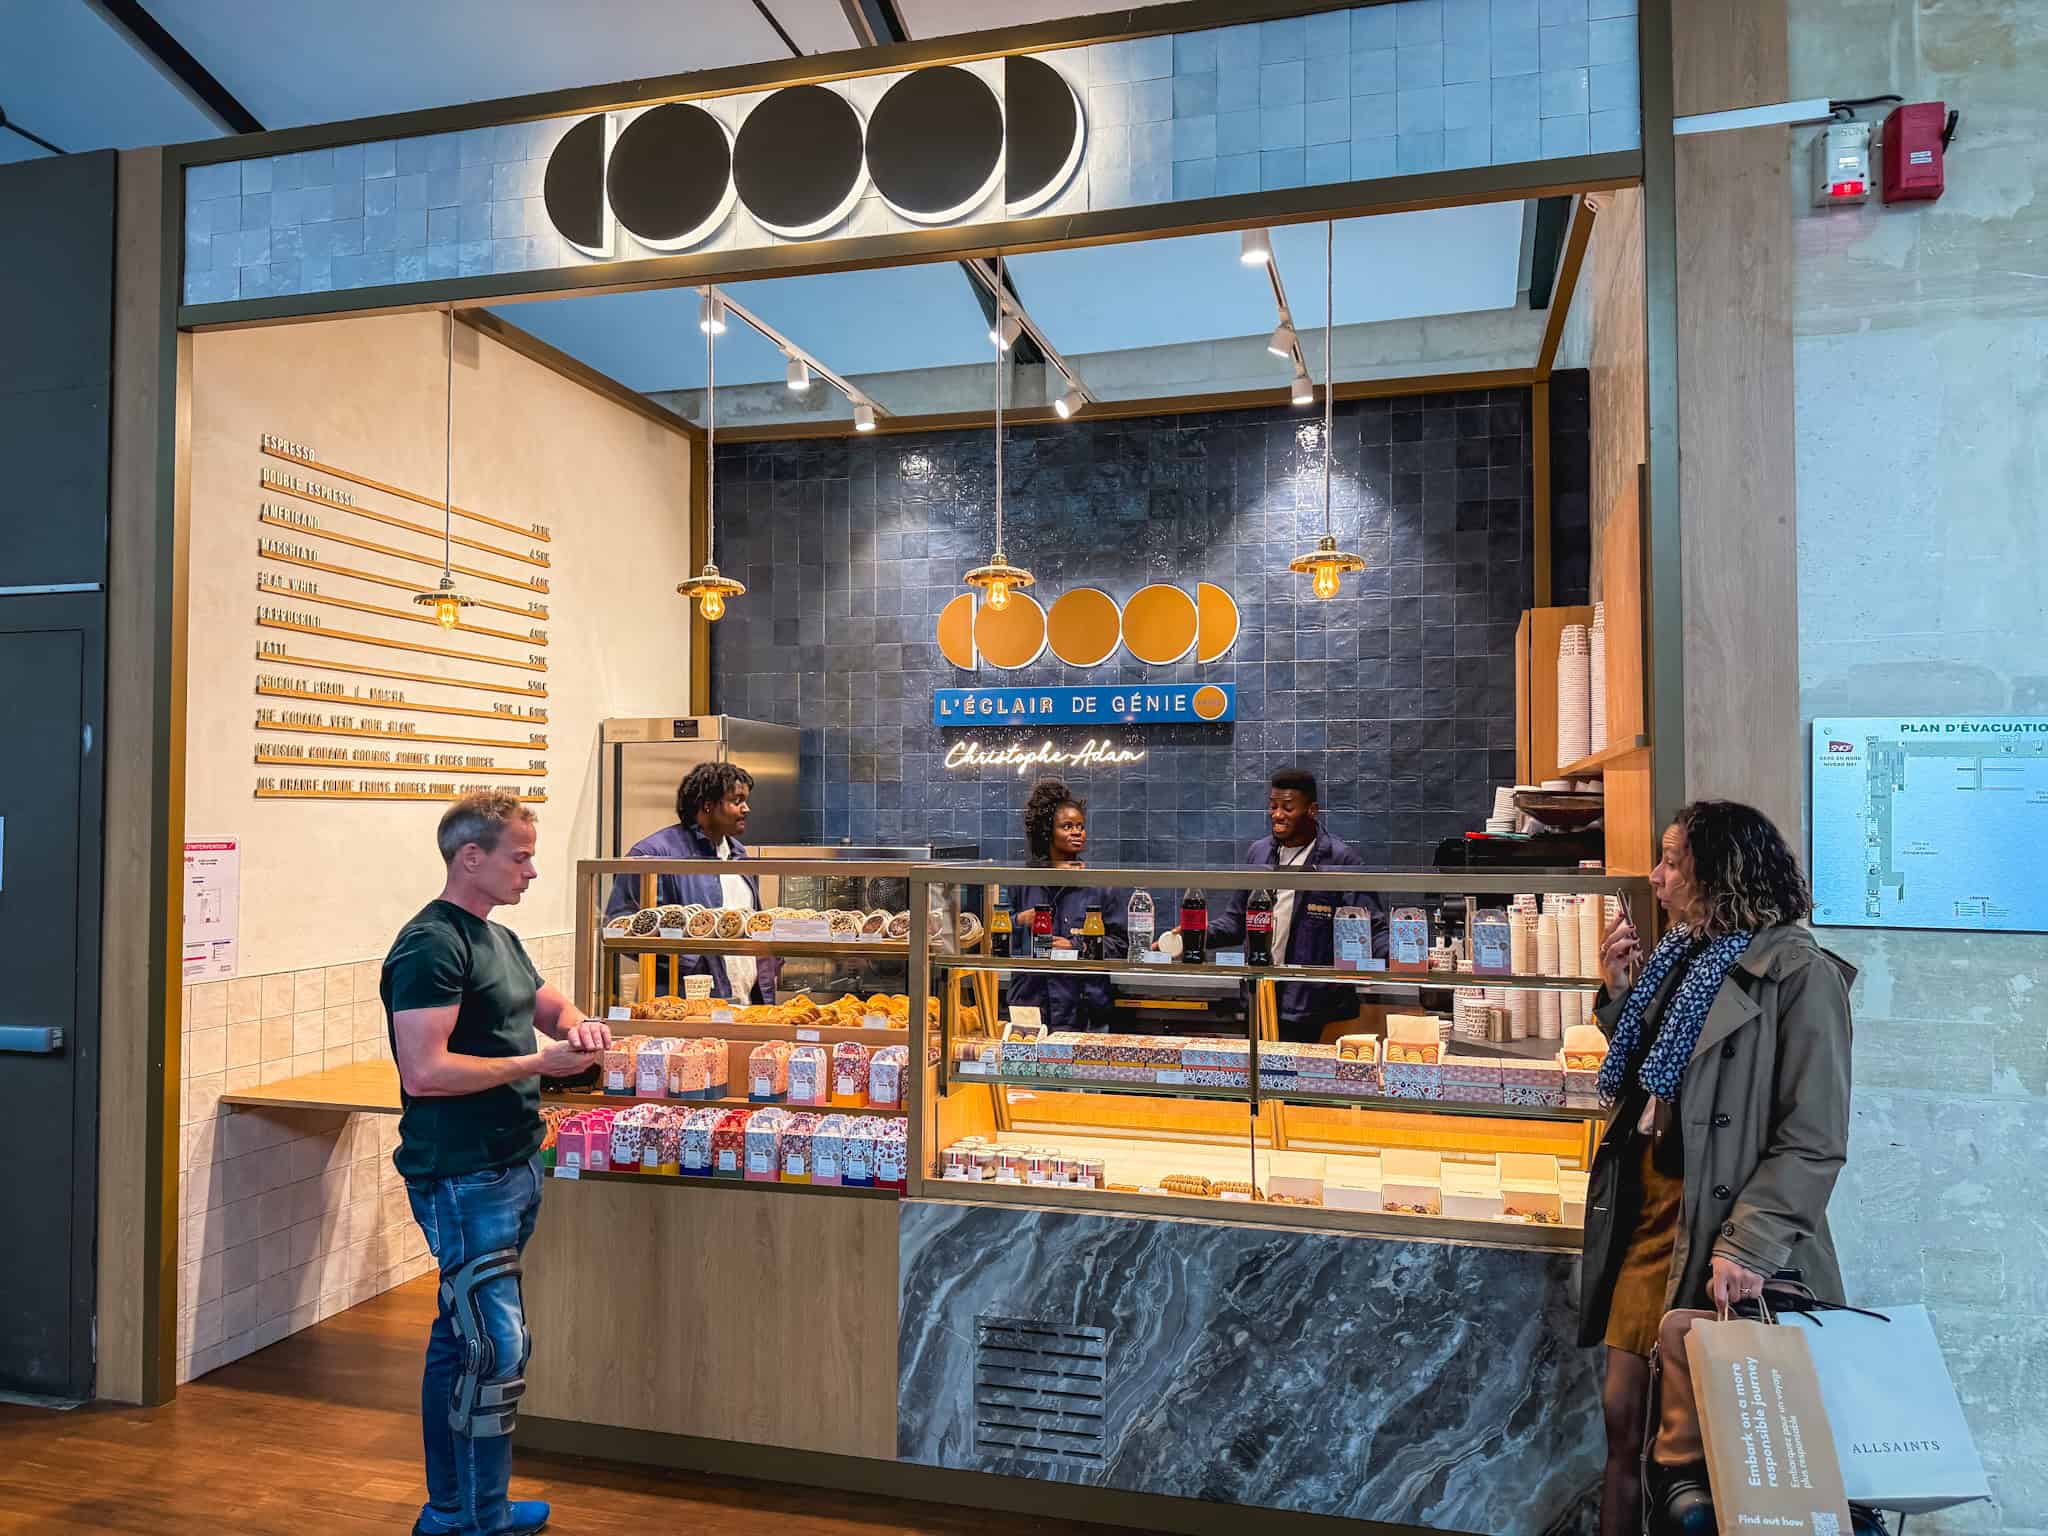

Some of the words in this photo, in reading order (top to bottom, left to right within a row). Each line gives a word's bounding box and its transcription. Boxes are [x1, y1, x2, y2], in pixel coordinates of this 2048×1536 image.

[262, 433, 316, 462] ESPRESSO
[262, 467, 302, 491] DOUBLE
[307, 482, 357, 507] ESPRESSO
[262, 502, 320, 529] AMERICANO
[259, 537, 319, 562] MACCHIATO
[940, 695, 1054, 716] L'ÉCLAIR
[1072, 696, 1097, 714] DE
[1111, 692, 1187, 713] GÉNIE
[1900, 723, 1940, 733] PLAN
[1944, 720, 2048, 733] D'ÉVACUATIO
[944, 740, 1069, 775] Christophe
[1069, 739, 1146, 767] Adam
[1732, 1362, 1745, 1396] more
[1745, 1356, 1768, 1407] journey
[1738, 1399, 1747, 1408] a
[1741, 1412, 1751, 1429] on
[1740, 1432, 1761, 1487] Embark
[1754, 1408, 1778, 1487] responsible
[1851, 1440, 1942, 1455] ALLSAINTS
[1738, 1513, 1761, 1525] Find
[1762, 1516, 1780, 1526] out
[1781, 1515, 1804, 1527] how
